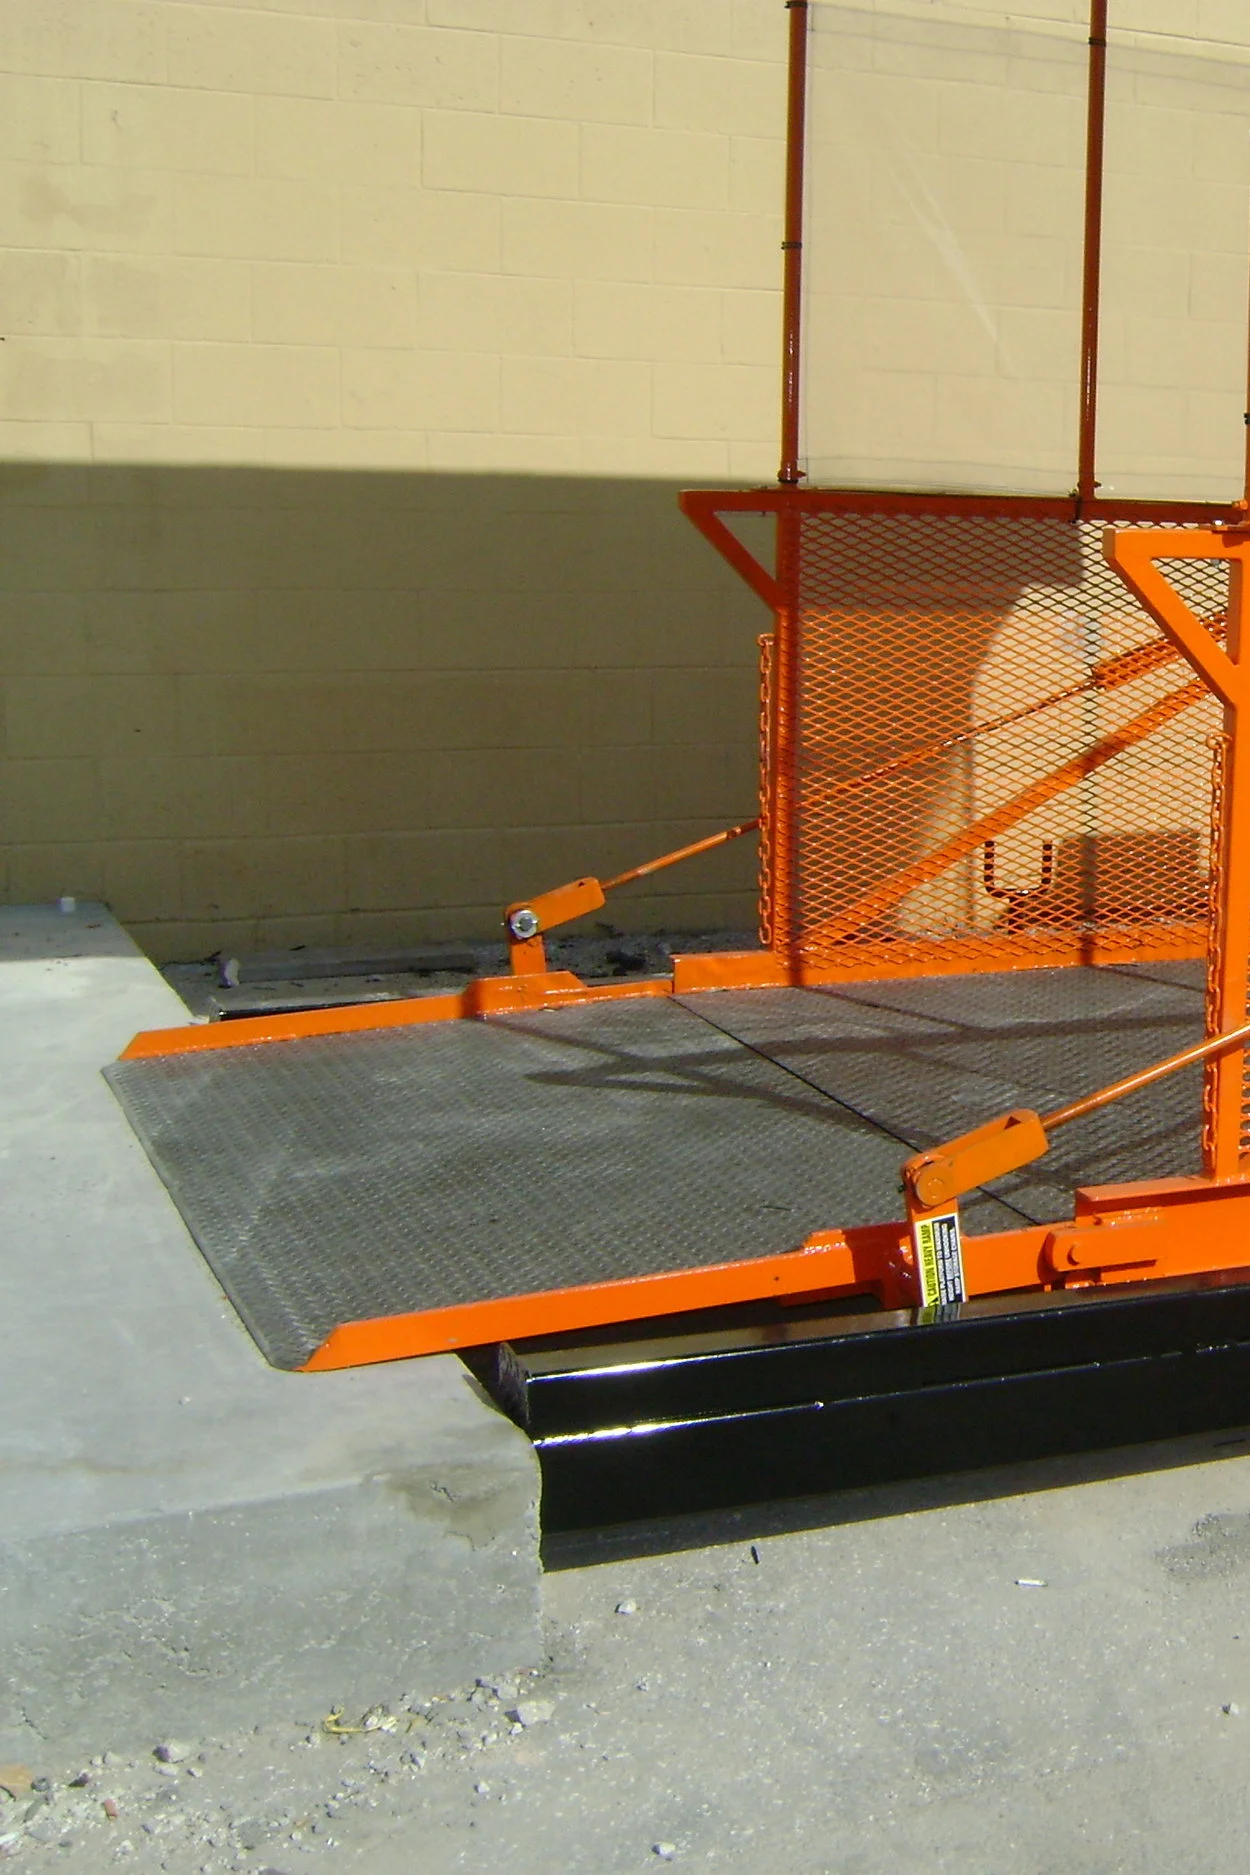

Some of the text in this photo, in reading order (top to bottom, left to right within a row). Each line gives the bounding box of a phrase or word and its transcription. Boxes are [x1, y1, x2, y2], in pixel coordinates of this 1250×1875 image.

[921, 1225, 936, 1296] CAUTION HEAVY RAMP
